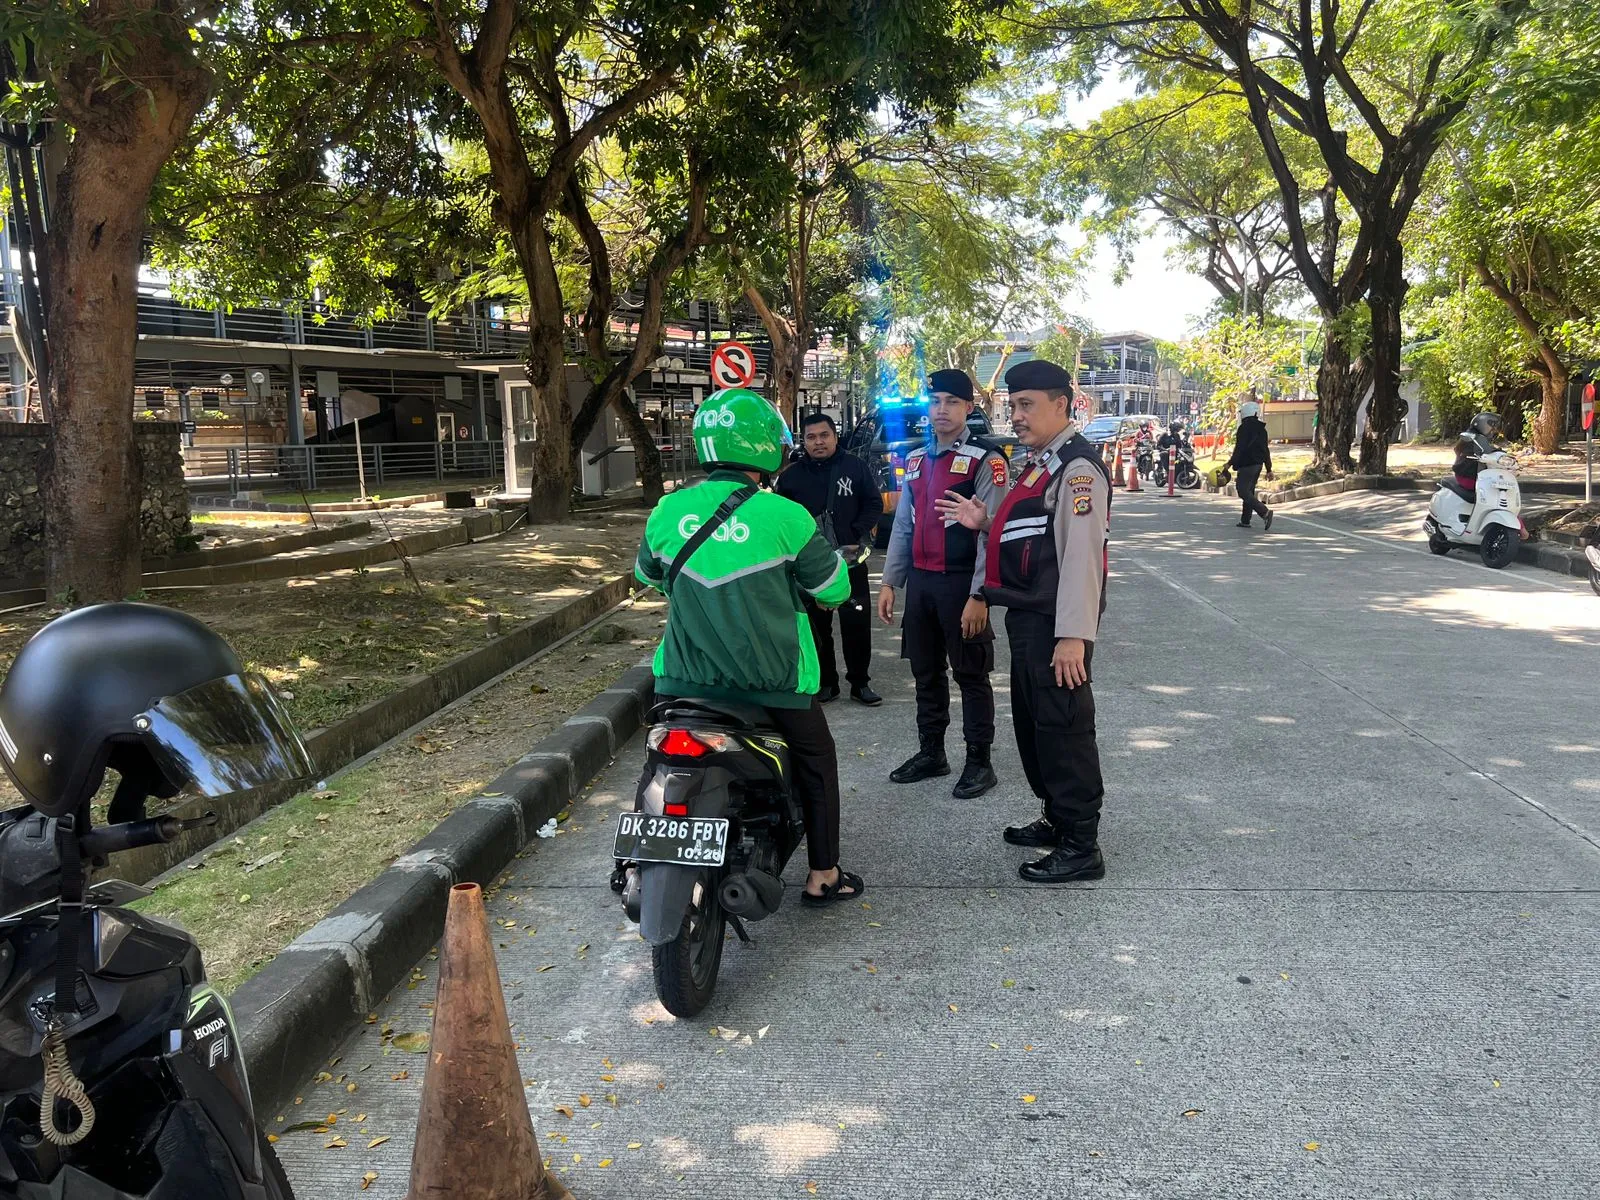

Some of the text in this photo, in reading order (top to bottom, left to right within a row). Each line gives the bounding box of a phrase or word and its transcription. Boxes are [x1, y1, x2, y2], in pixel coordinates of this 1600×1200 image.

[721, 348, 746, 384] S
[693, 403, 736, 430] rab
[836, 475, 854, 496] NY
[677, 513, 751, 544] Gab
[620, 816, 726, 843] DK 3286 FBY
[192, 1017, 228, 1041] HONDA
[208, 1034, 230, 1069] FI
